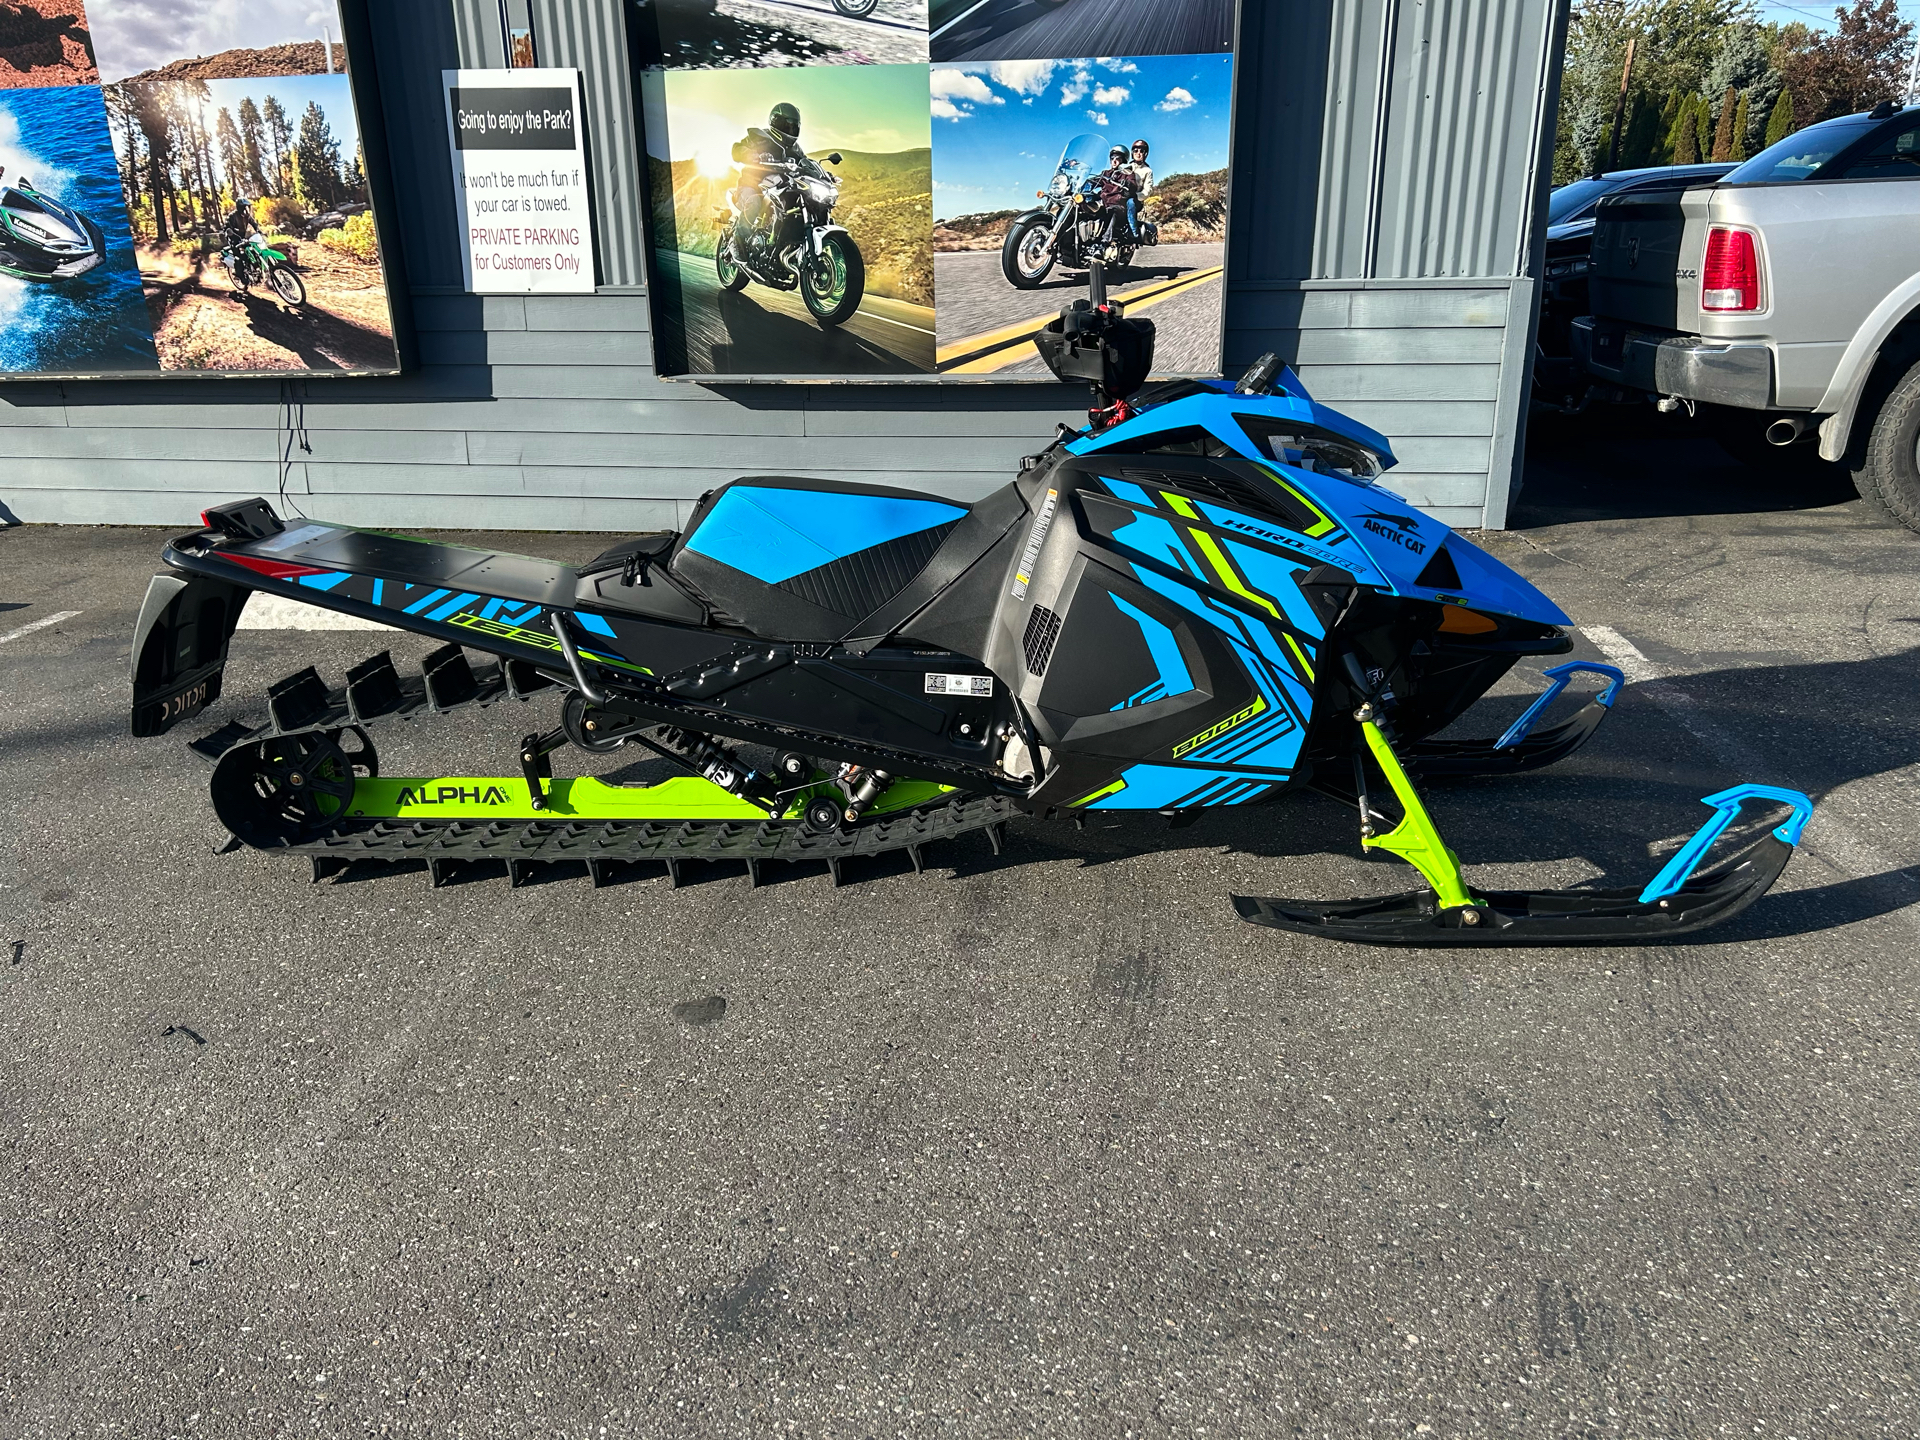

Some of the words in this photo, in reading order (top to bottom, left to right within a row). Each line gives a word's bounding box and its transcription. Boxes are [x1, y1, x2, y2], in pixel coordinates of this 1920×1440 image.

[457, 109, 486, 134] Going
[486, 110, 496, 129] to
[499, 109, 524, 134] enjoy
[525, 109, 541, 129] the
[543, 109, 571, 129] Park?
[459, 171, 467, 188] It
[469, 171, 498, 188] won't
[500, 171, 515, 188] be
[517, 170, 548, 187] much
[551, 169, 568, 187] fun
[572, 169, 579, 186] if
[474, 199, 498, 217] your
[501, 199, 519, 212] car
[521, 195, 531, 212] is
[533, 194, 571, 212] towed.
[13, 217, 47, 239] Kawasaki
[471, 228, 521, 245] PRIVATE
[524, 228, 579, 245] PARKING
[475, 253, 489, 270] for
[492, 252, 551, 270] Customers
[554, 253, 580, 275] Only
[1363, 518, 1404, 546] ARCTIC
[1405, 538, 1426, 555] CAT
[1174, 703, 1256, 758] 8000
[395, 786, 506, 807] ALPHA
[499, 786, 512, 803] ONE
